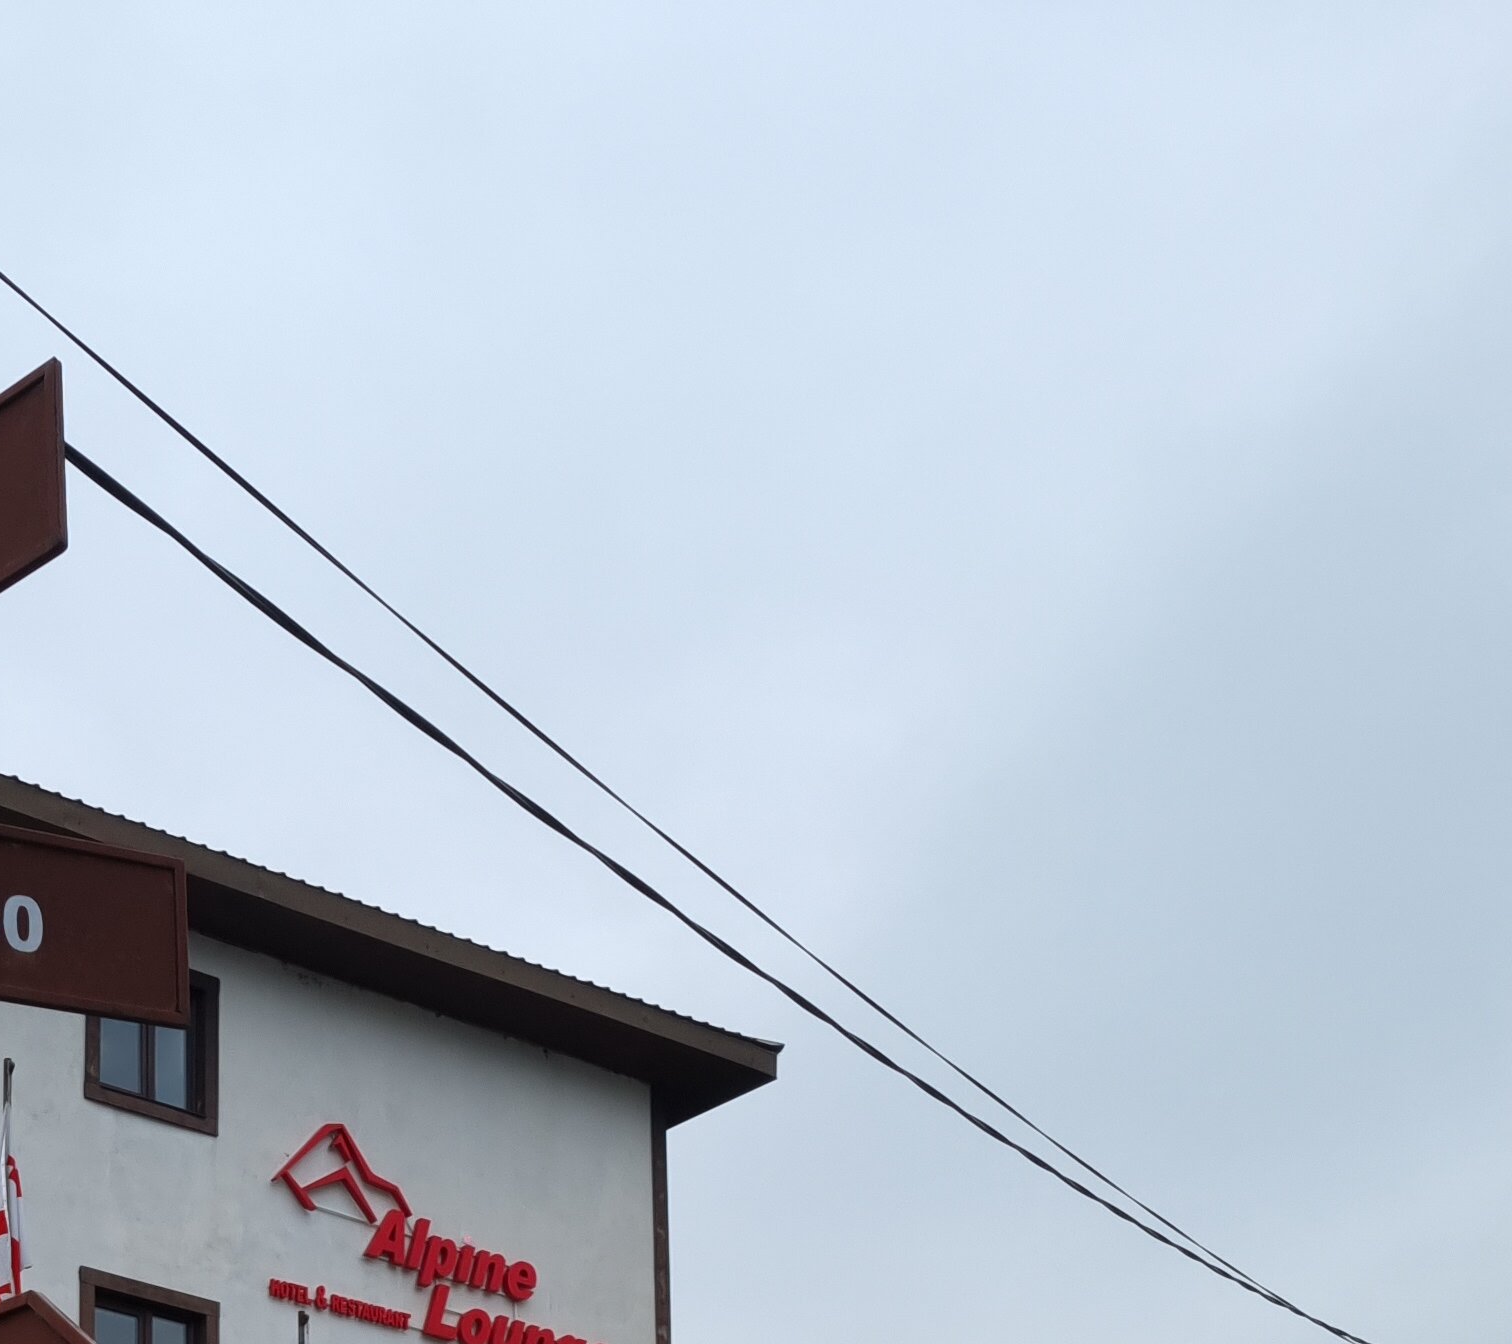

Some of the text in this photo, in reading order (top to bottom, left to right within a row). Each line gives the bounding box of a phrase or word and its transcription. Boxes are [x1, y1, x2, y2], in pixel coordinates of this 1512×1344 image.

[363, 1208, 537, 1302] Alpine
[268, 1278, 411, 1330] HOTEL & RESTAURANT
